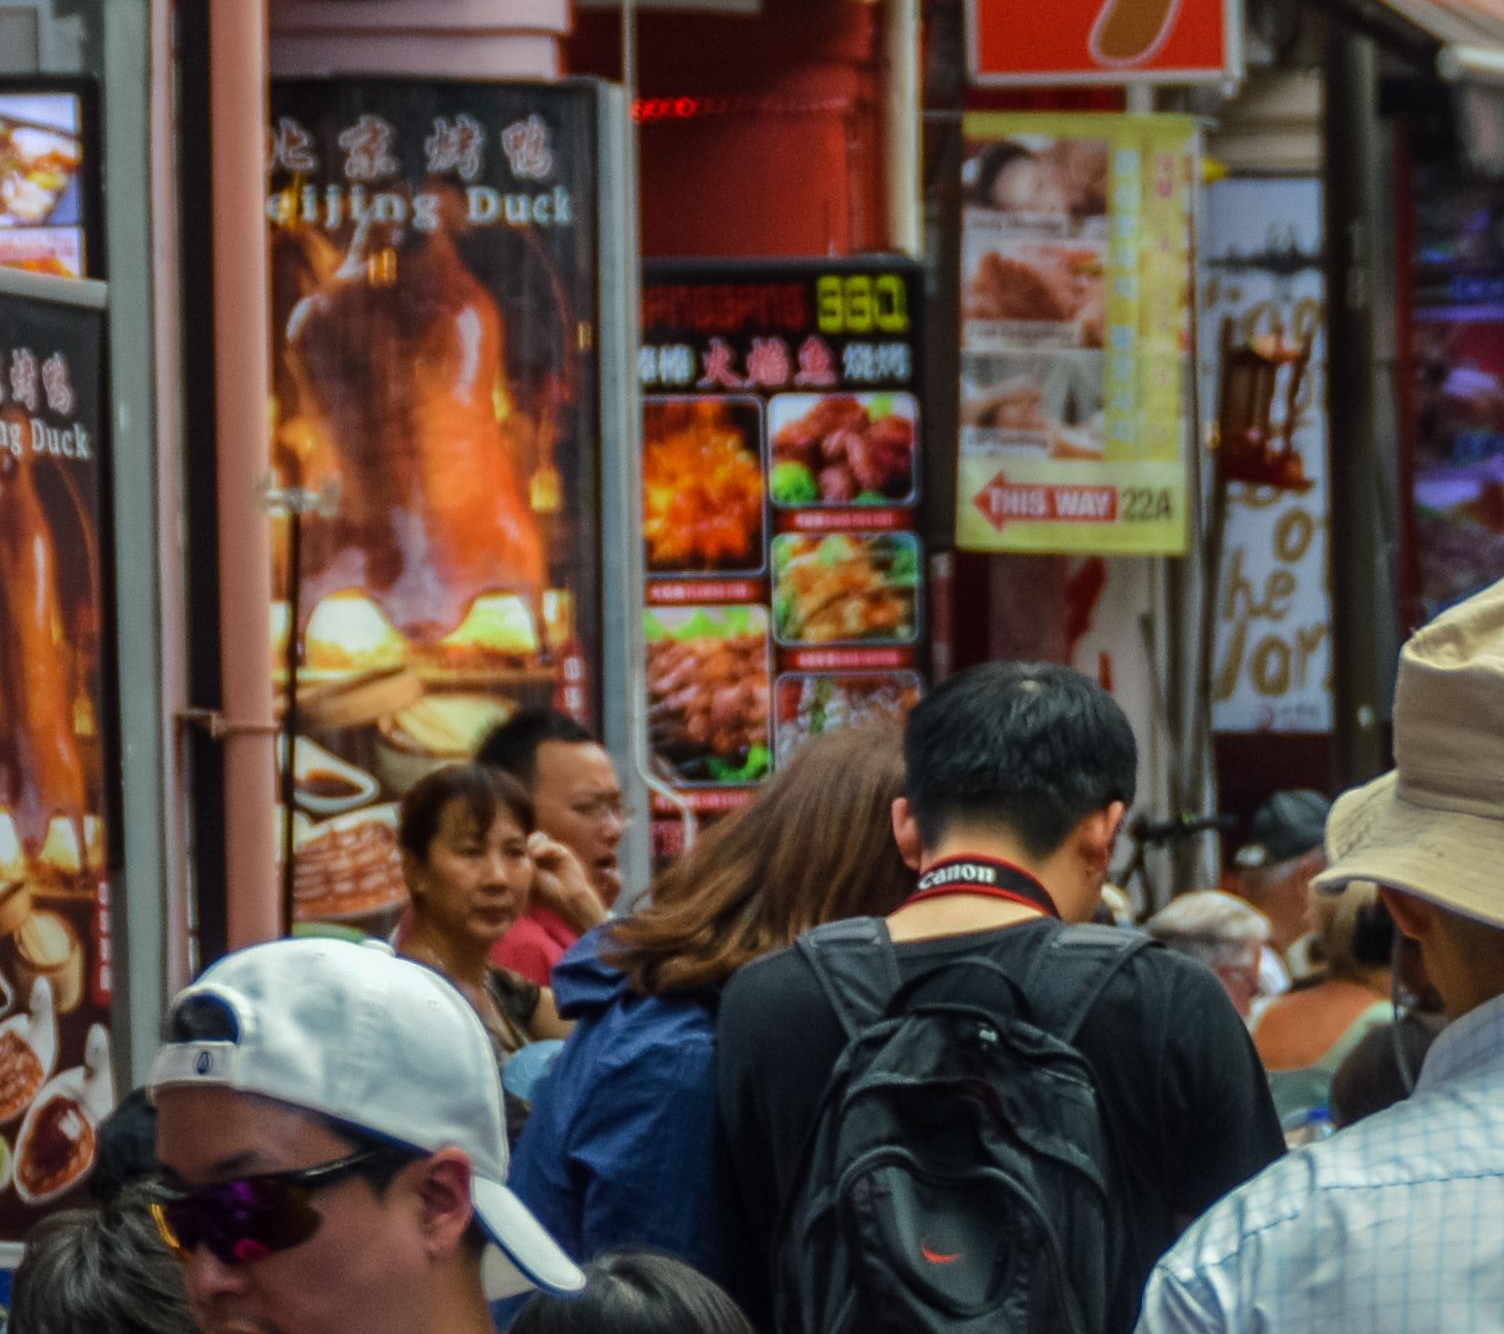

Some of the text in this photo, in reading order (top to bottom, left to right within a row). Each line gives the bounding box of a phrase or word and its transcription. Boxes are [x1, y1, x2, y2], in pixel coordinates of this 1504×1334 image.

[267, 183, 573, 231] eijing Duck
[30, 417, 92, 460] Duck
[991, 484, 1173, 521] THIS WAY 22A
[918, 864, 995, 890] Canon
